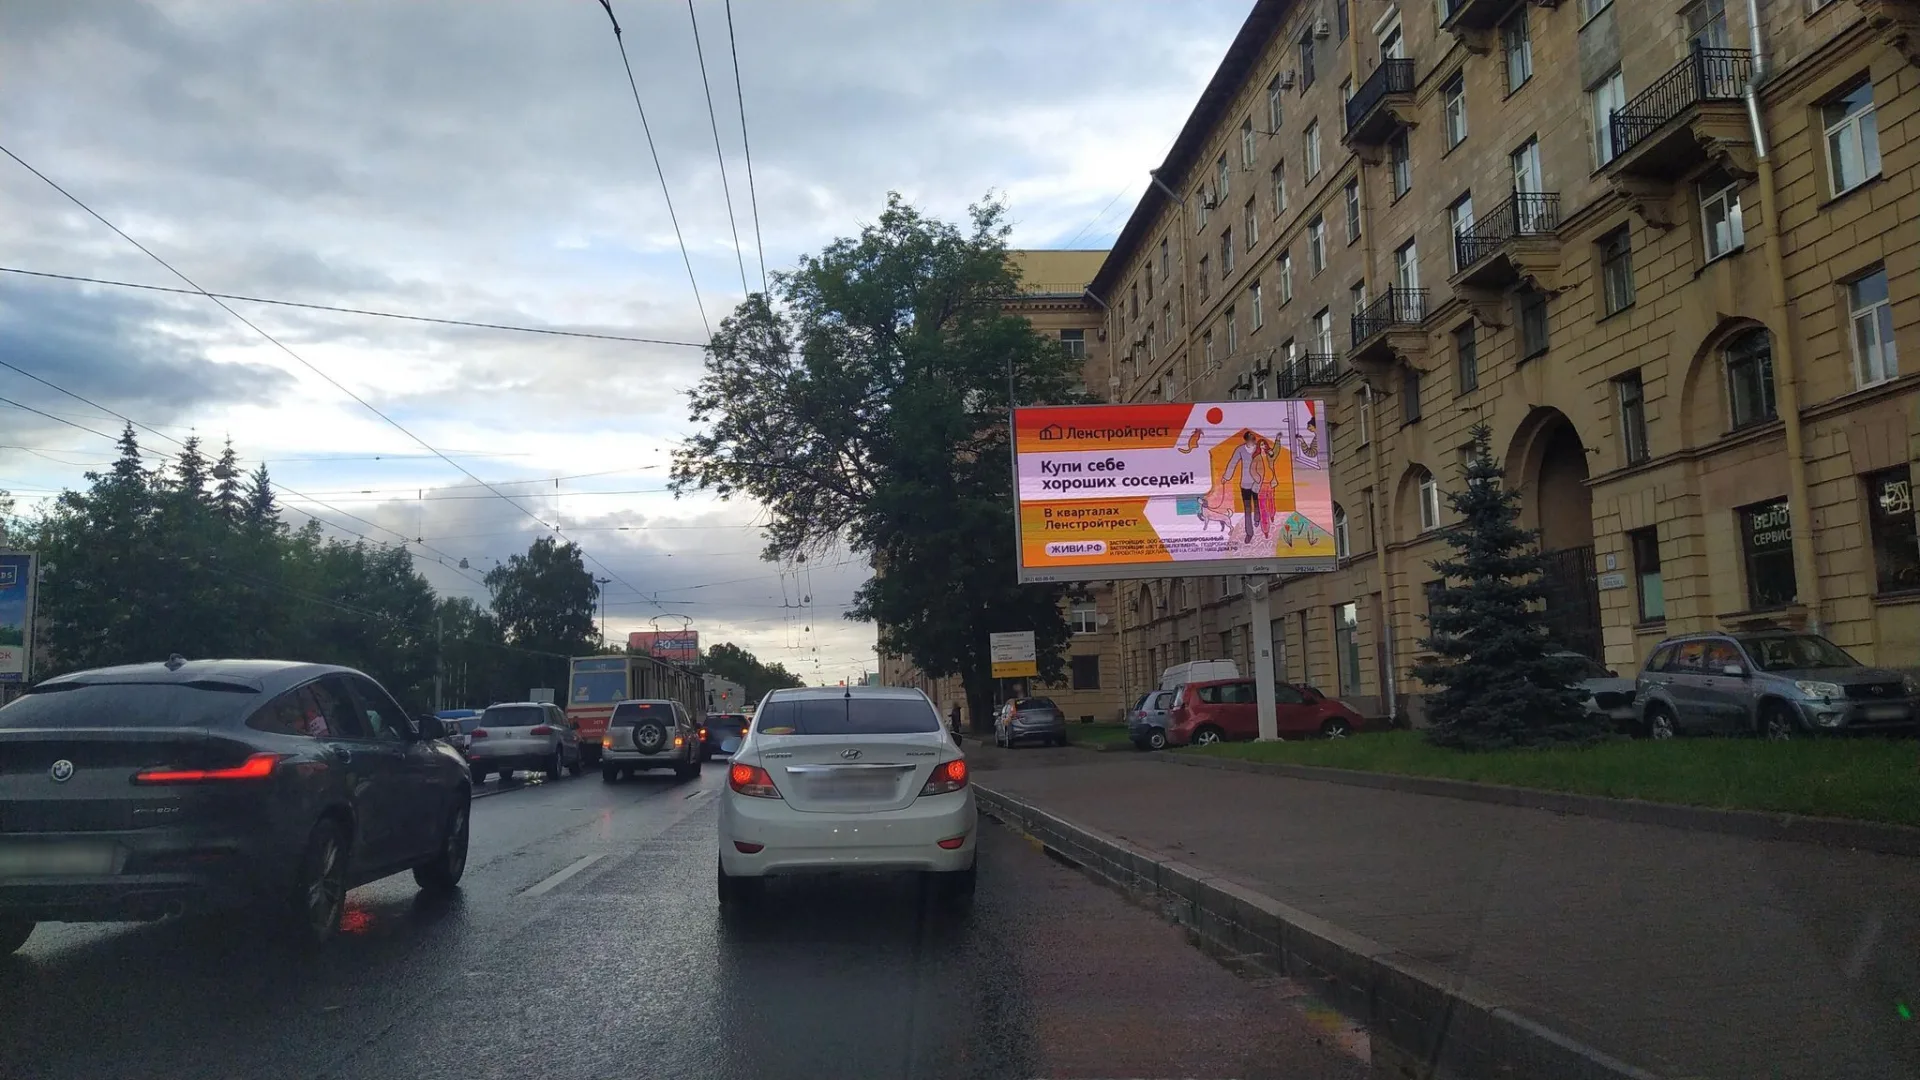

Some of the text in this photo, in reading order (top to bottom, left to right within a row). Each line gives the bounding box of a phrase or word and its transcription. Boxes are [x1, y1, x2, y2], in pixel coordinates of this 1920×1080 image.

[1066, 425, 1170, 441] Ленстройтрест
[1041, 457, 1125, 477] Купи себе
[1042, 472, 1194, 492] хороших соседей!
[1044, 508, 1119, 520] В кварталах
[1754, 511, 1788, 529] ВЕЛО
[1045, 518, 1138, 531] Ленстройтрест
[1754, 528, 1792, 546] СЕРВИС
[1051, 544, 1103, 554] ЖИВИ.РФ
